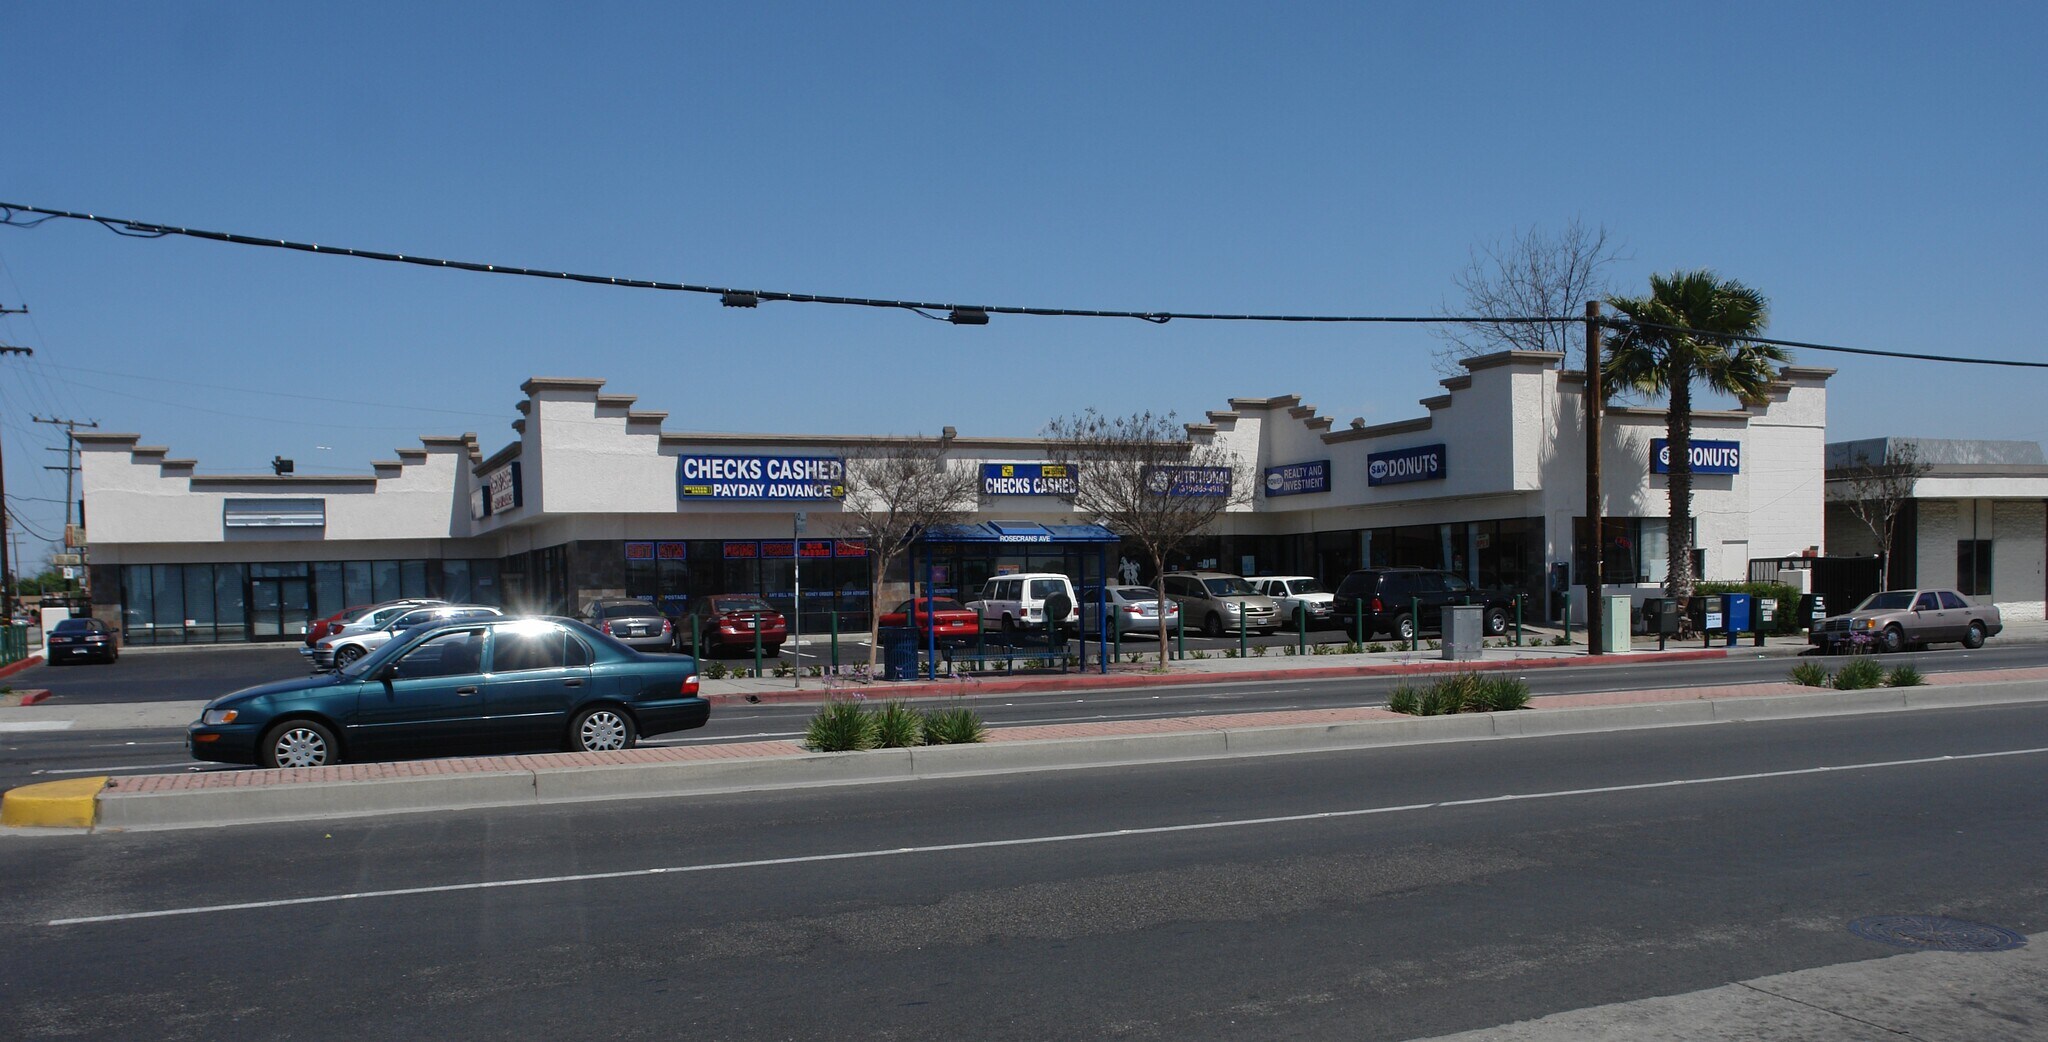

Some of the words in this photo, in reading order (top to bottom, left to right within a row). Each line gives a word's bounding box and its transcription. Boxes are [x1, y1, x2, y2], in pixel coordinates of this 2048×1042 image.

[683, 458, 762, 480] CHECKS
[767, 459, 843, 480] CASHED
[1283, 468, 1308, 479] REALTY
[1308, 465, 1323, 476] AND
[1371, 463, 1387, 475] S&K
[1389, 453, 1438, 477] DONUTS
[713, 484, 765, 497] PAYDAY
[768, 484, 832, 497] ADVANCE
[985, 477, 1031, 494] CHECKS
[1033, 478, 1077, 494] CASHED
[1283, 477, 1324, 491] INVESTMENT
